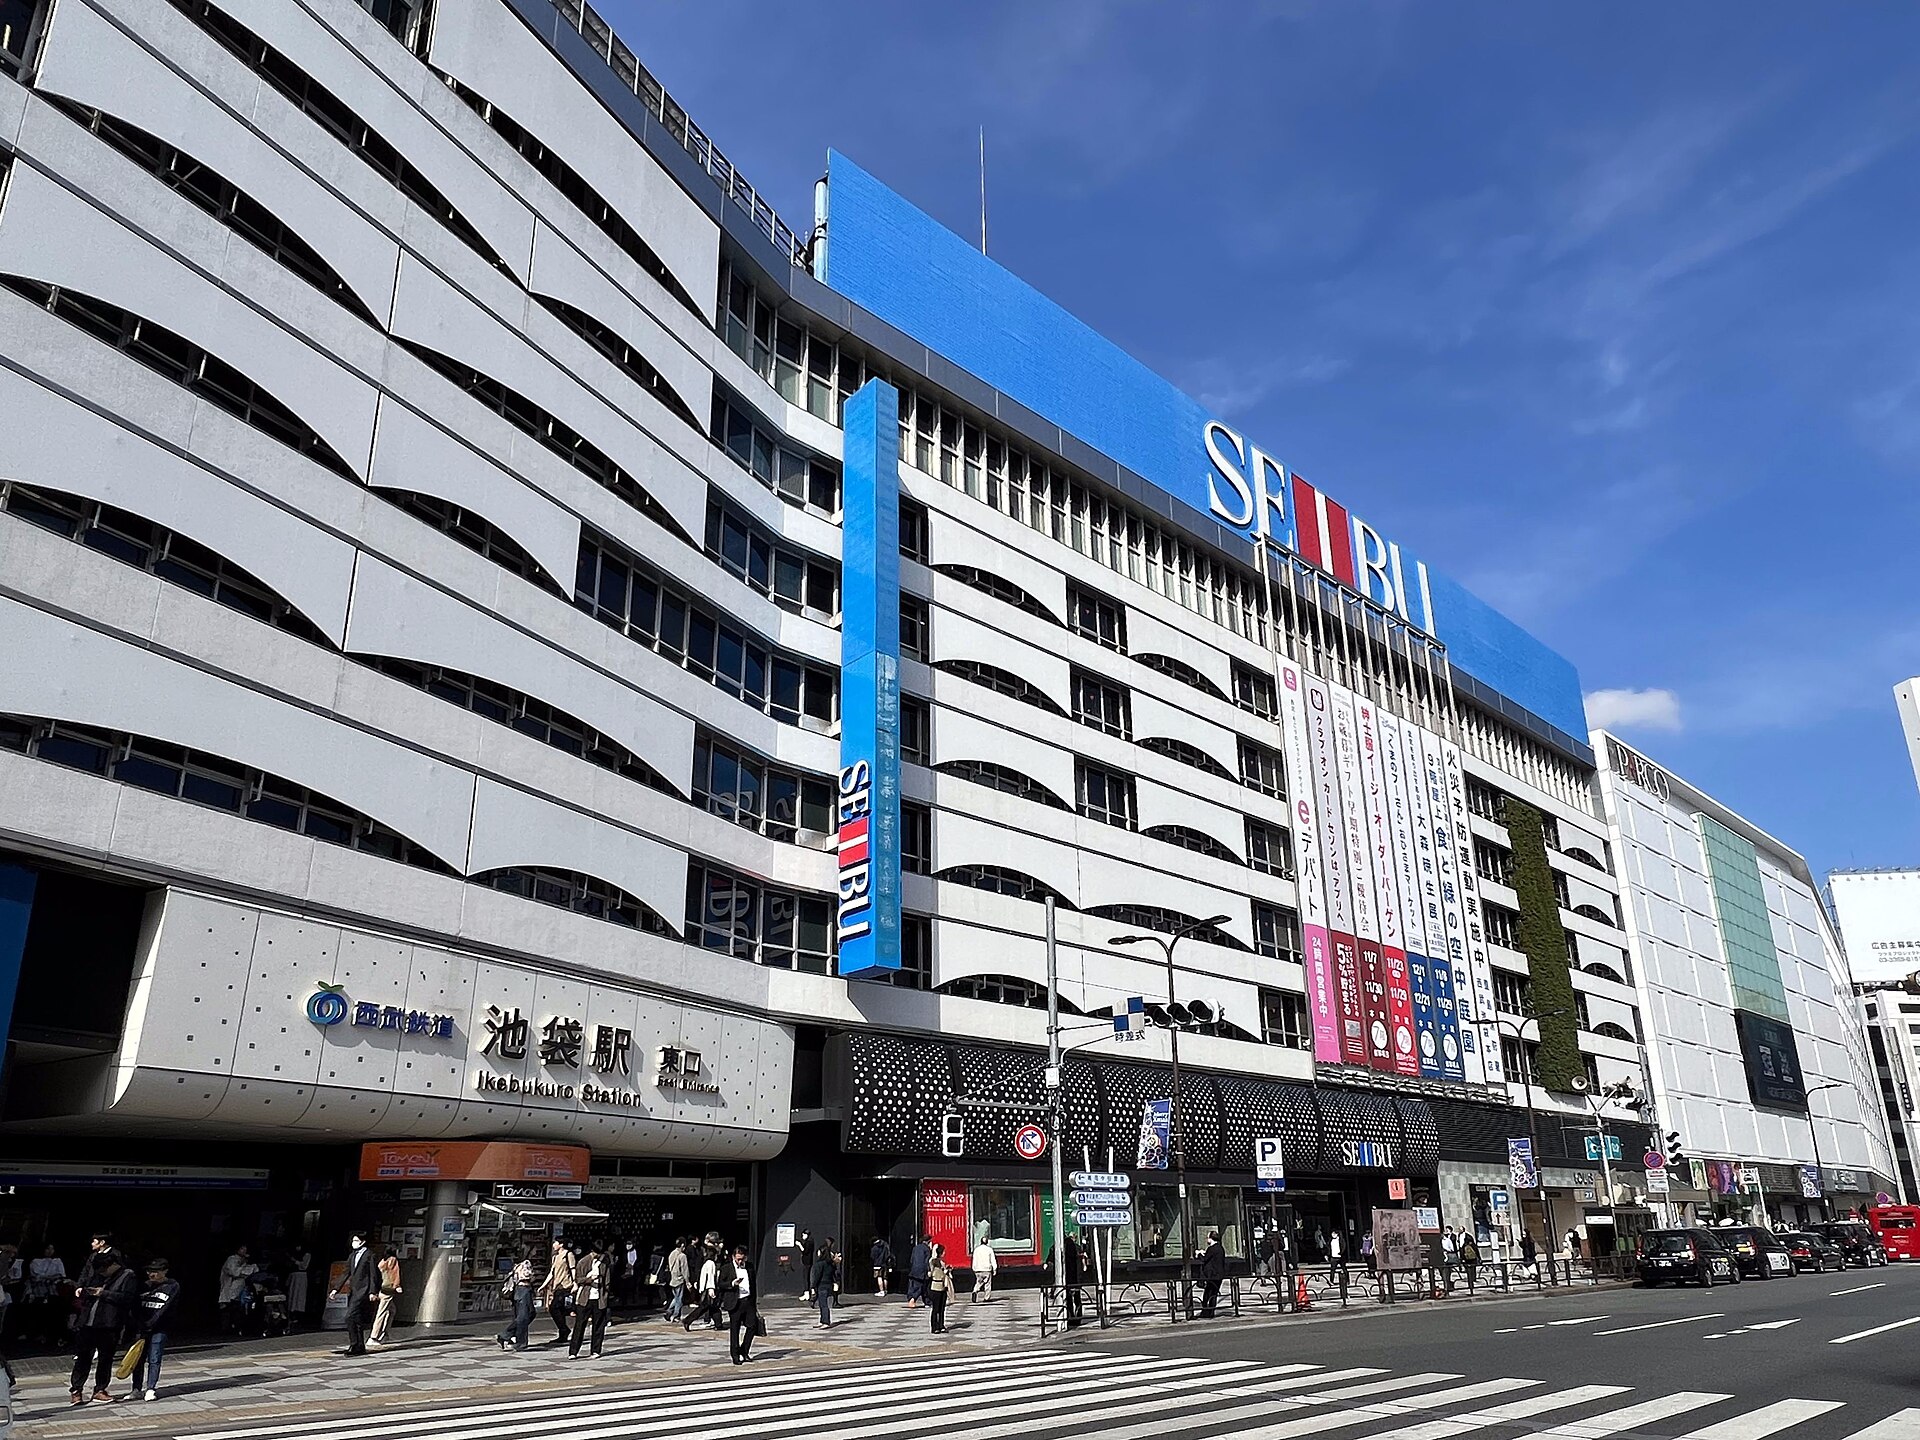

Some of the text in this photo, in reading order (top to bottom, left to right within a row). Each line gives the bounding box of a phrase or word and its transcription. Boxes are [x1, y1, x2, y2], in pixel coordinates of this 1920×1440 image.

[1203, 419, 1437, 640] SEIBU
[1617, 745, 1669, 801] PARCO
[837, 759, 870, 943] SEIBU
[351, 1000, 453, 1039] 西武鉄道
[1114, 1030, 1146, 1042] 時差式
[480, 1003, 702, 1077] 池袋駅 東口
[475, 1069, 722, 1108] Ikebukuro Station East Entrance
[1260, 1141, 1277, 1162] P
[1341, 1140, 1394, 1169] SEIBU
[496, 1185, 546, 1199] TOMONY
[1492, 1191, 1509, 1211] P
